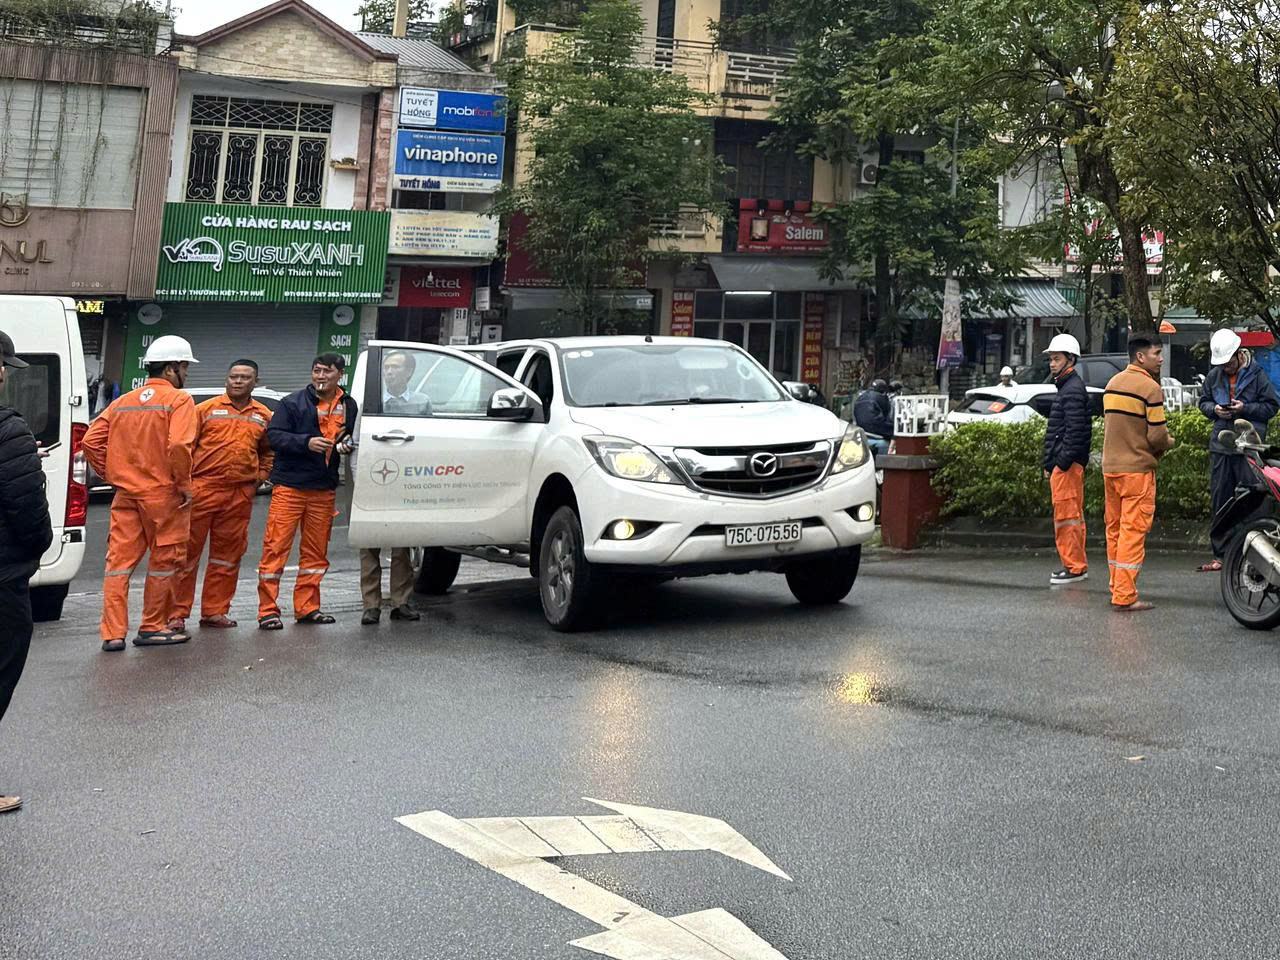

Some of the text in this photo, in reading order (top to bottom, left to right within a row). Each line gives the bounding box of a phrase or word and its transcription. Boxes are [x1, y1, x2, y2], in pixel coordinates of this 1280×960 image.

[406, 97, 434, 106] TUYẾT
[407, 108, 431, 117] HỒNG
[404, 145, 498, 164] vinaphone
[400, 178, 420, 188] TUYẾT
[201, 212, 351, 234] CỬA HÀNG RAU SẠCH
[785, 226, 824, 240] Salem
[228, 240, 365, 266] SusuXANH
[288, 268, 313, 277] Thiên
[315, 268, 342, 277] Nhiên
[412, 277, 461, 289] viettel
[330, 334, 352, 349] SẠCH
[404, 465, 466, 477] EVNCPC
[728, 524, 799, 544] 75C-075.56
